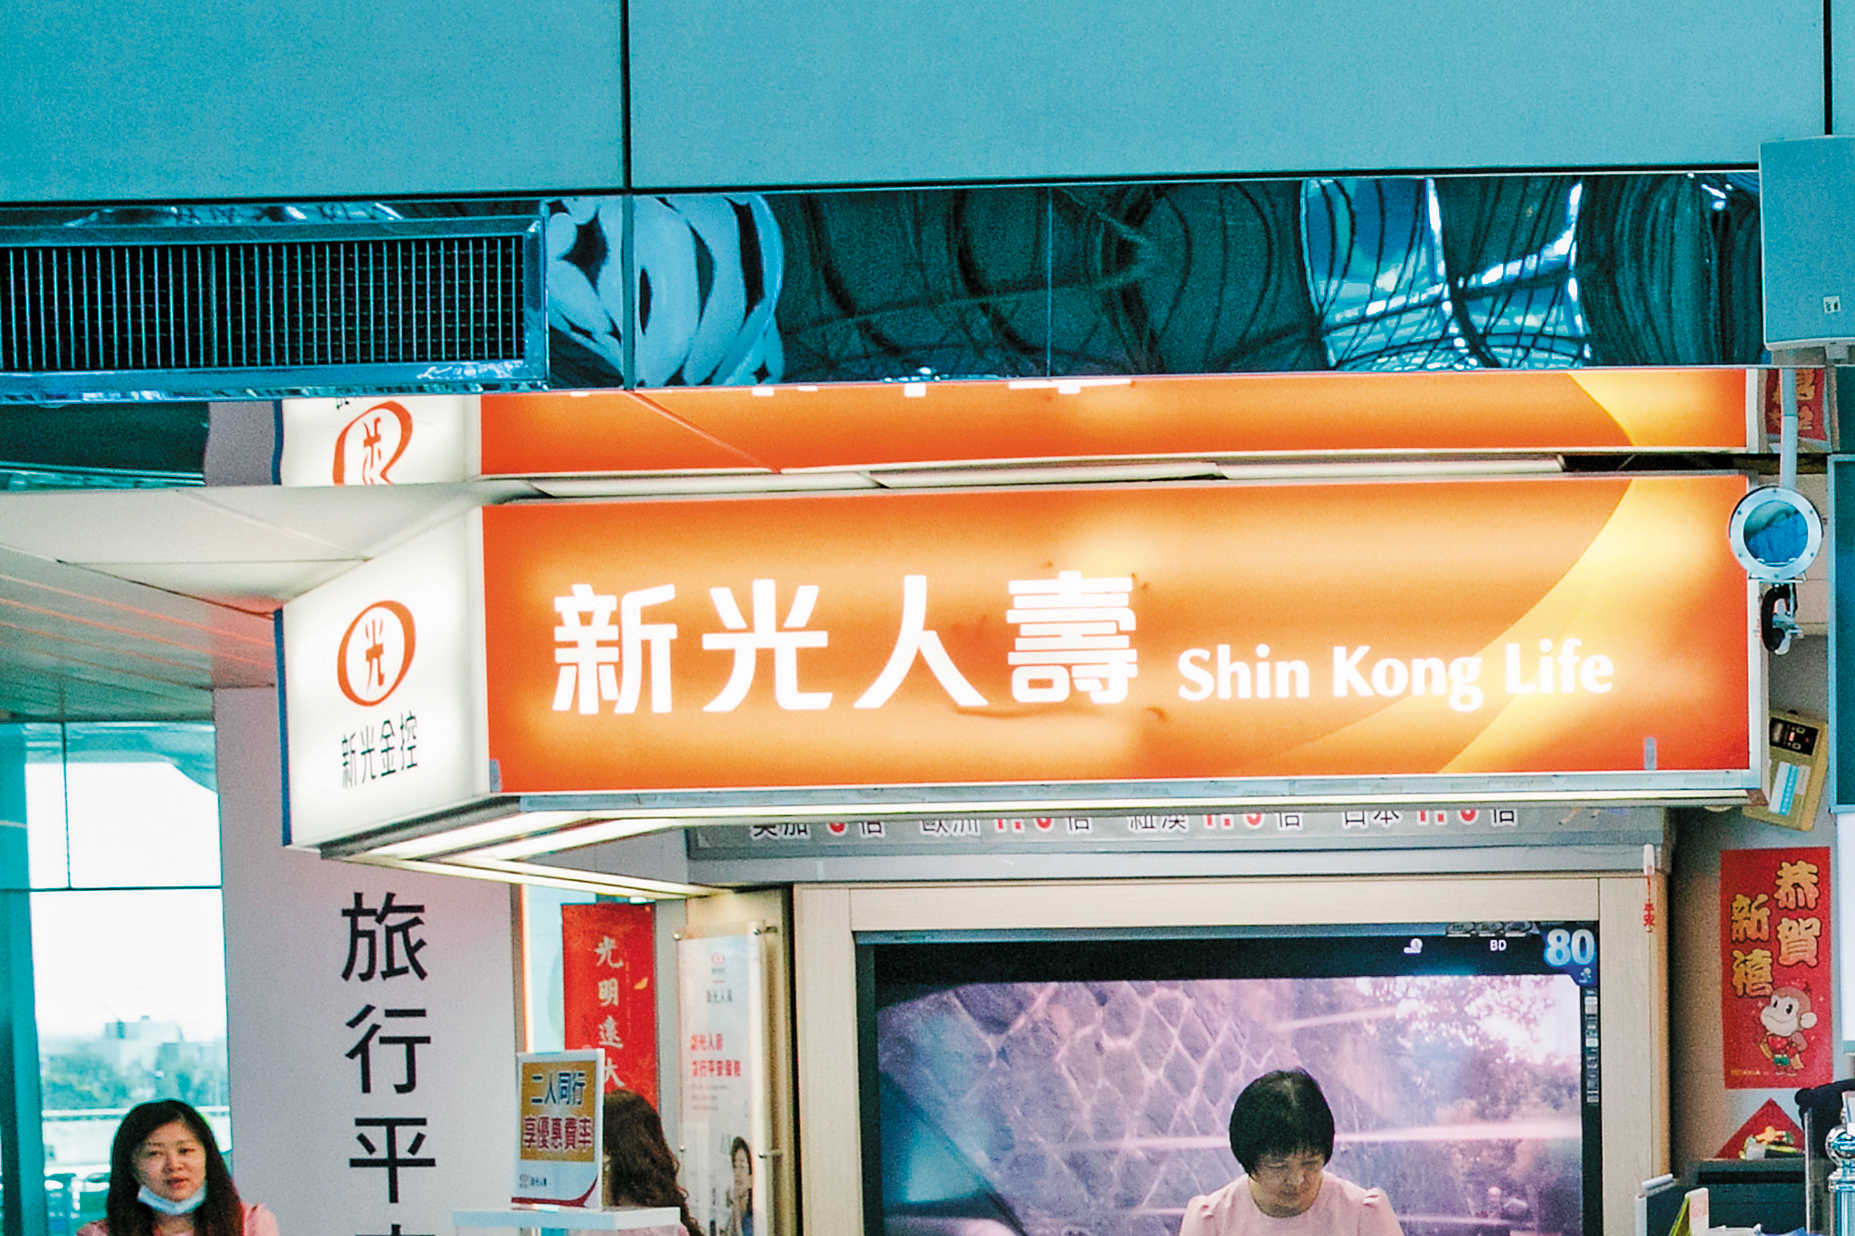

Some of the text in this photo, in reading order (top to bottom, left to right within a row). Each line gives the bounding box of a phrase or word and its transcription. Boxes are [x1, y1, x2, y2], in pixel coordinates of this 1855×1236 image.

[552, 571, 1138, 715] 新光人壽
[1178, 638, 1614, 713] Shin Kong Life
[340, 710, 419, 789] 新光金控
[1729, 893, 1774, 998] 新禧
[1773, 859, 1822, 968] 恭賀
[530, 1071, 587, 1106] 二人同行
[523, 1116, 592, 1150] 享優惠費率
